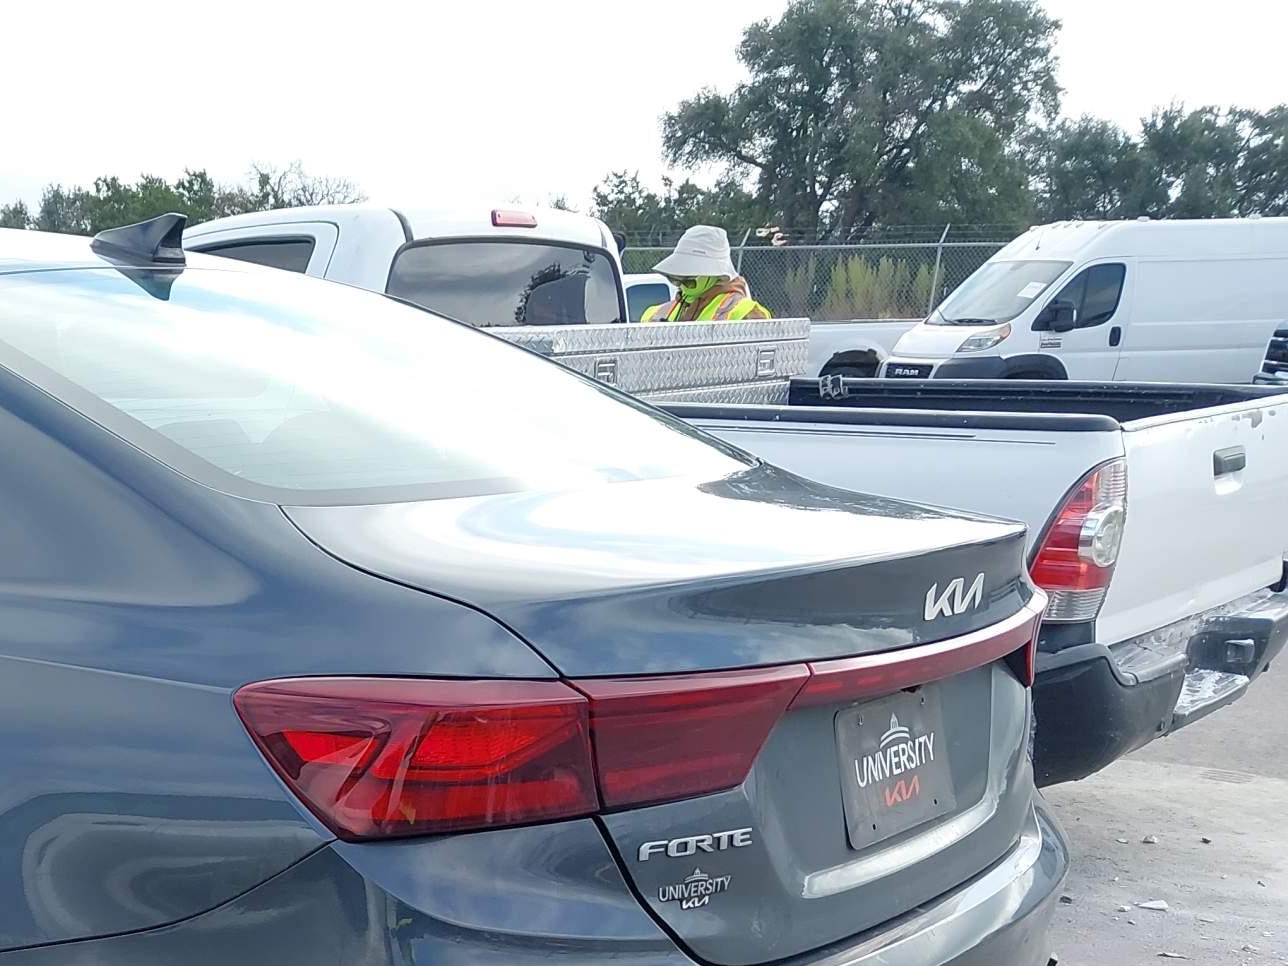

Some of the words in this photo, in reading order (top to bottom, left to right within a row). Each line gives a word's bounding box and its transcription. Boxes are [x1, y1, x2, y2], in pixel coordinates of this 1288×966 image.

[895, 368, 919, 376] RAM
[924, 573, 985, 621] KIA
[854, 732, 935, 788] UNIVERSITY
[885, 775, 920, 807] KIA
[638, 827, 753, 862] FORTE
[659, 874, 732, 902] UNIVERSITY
